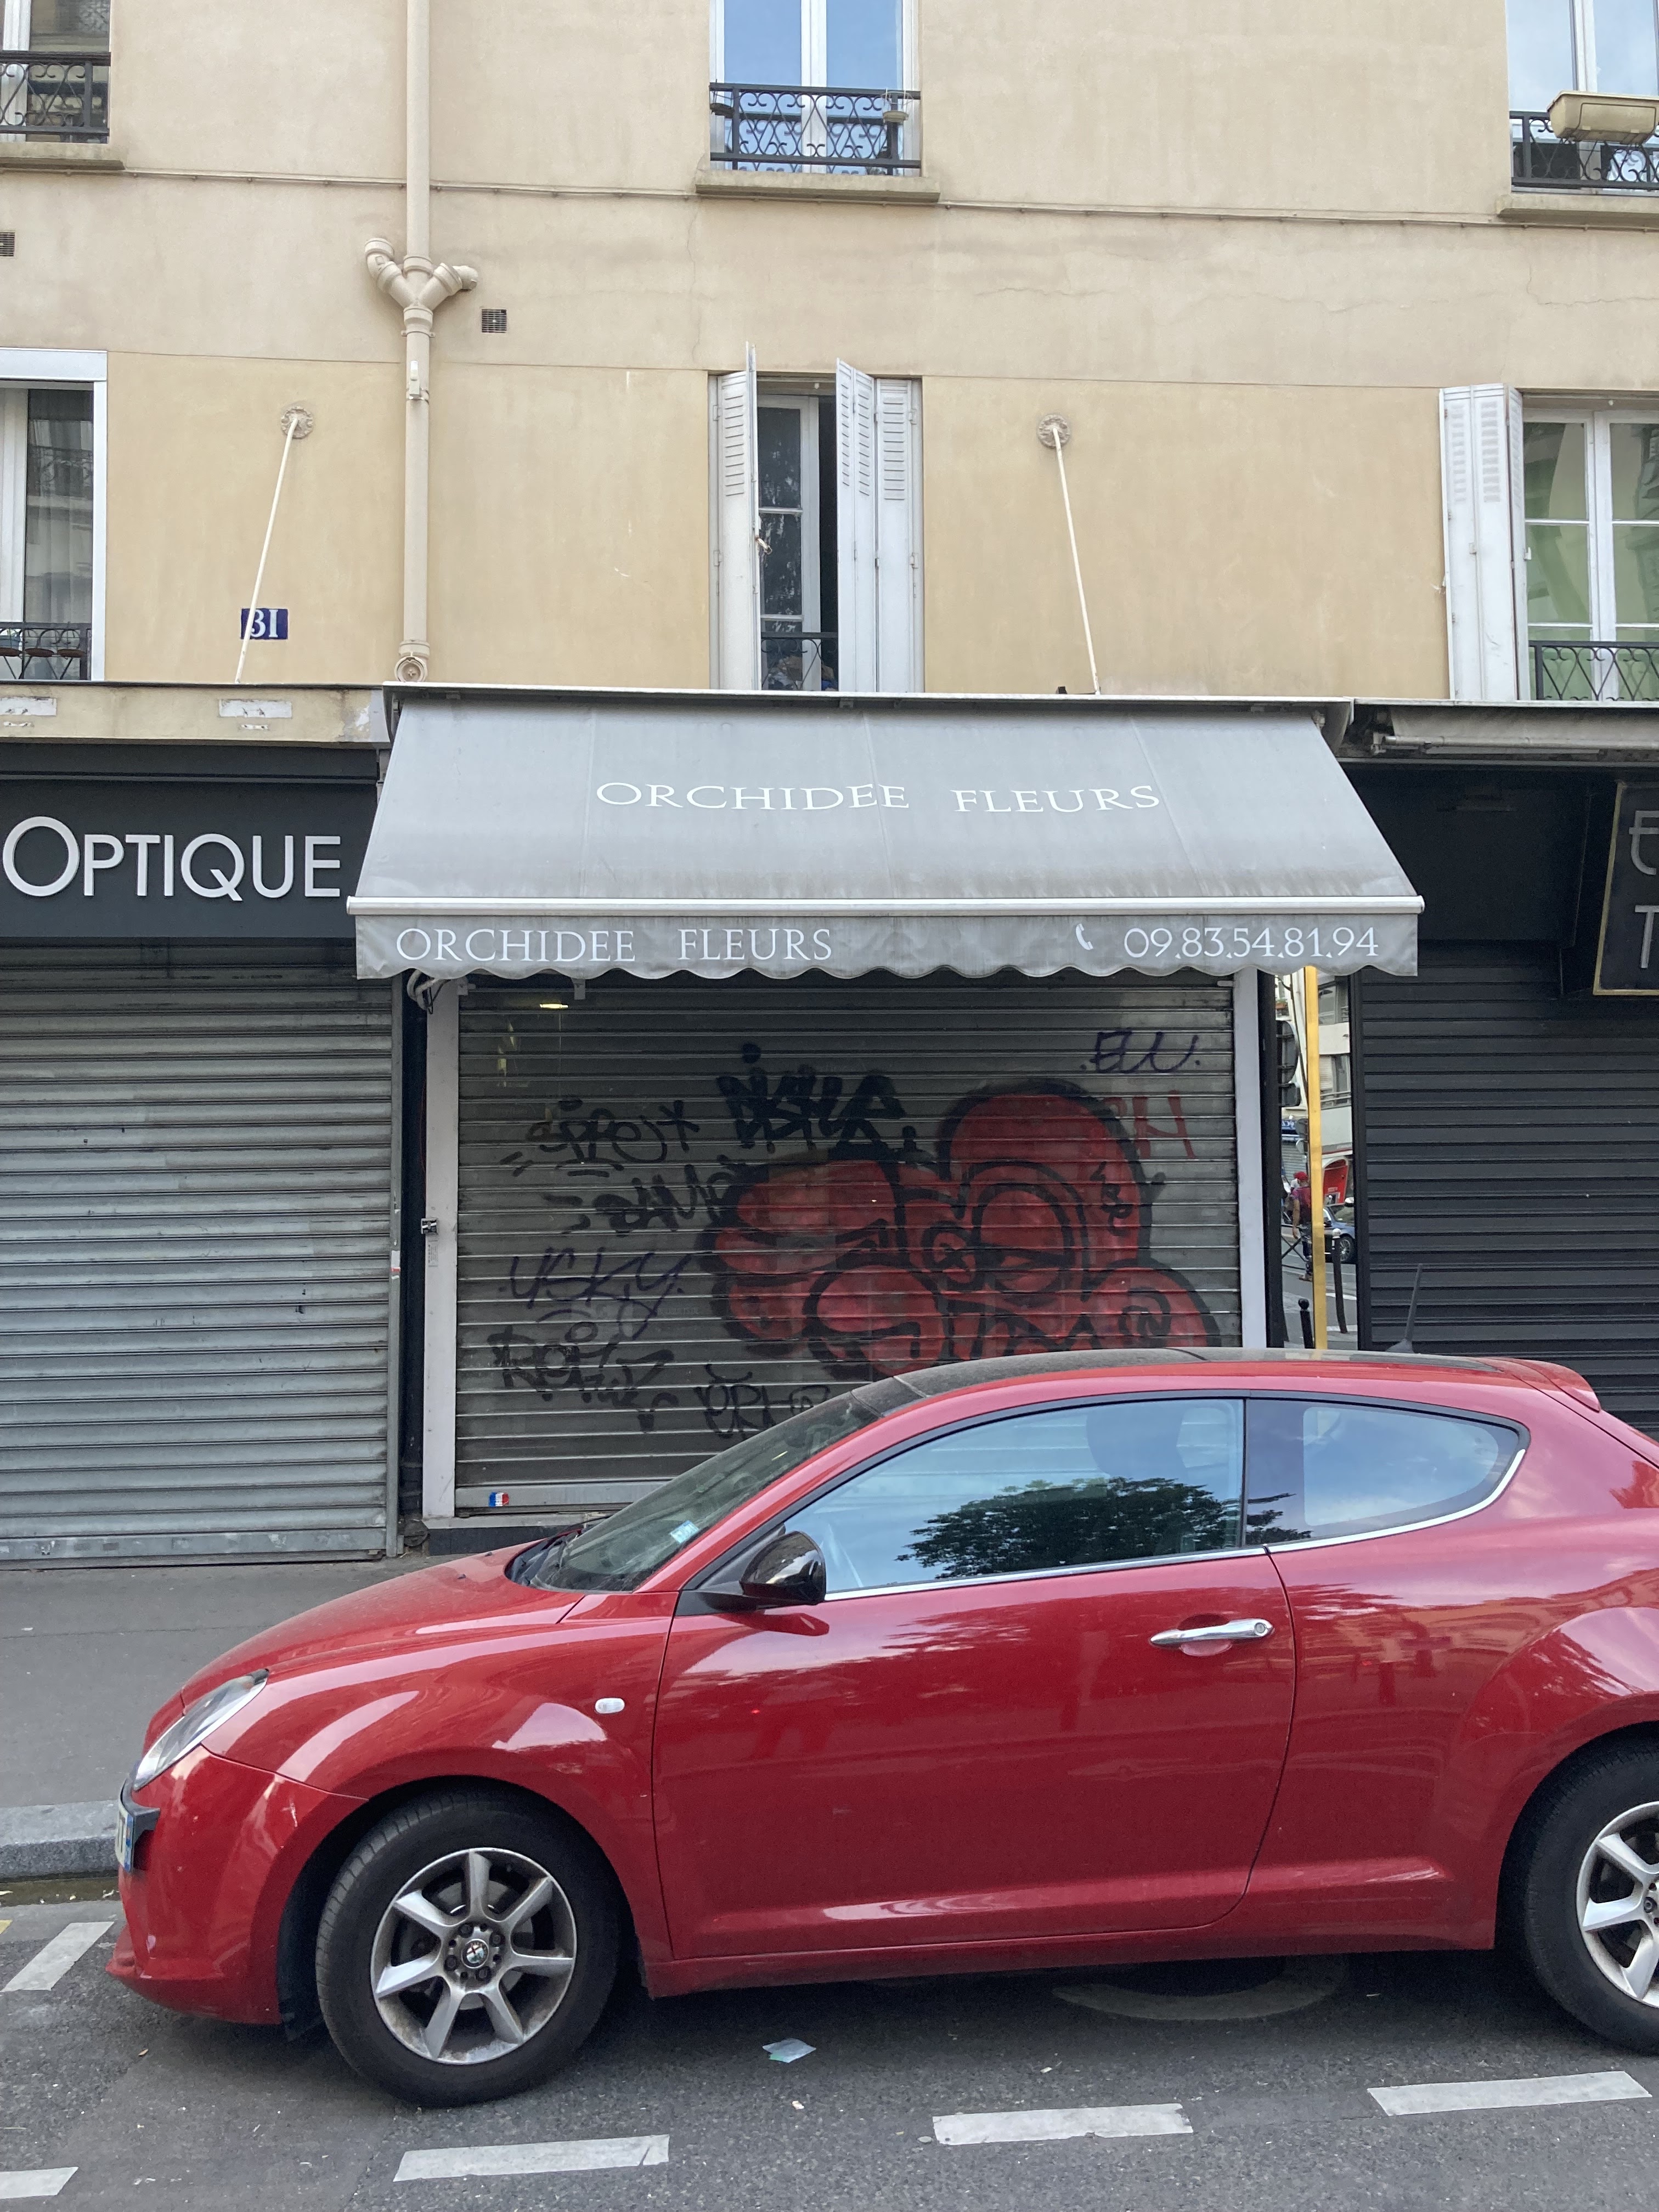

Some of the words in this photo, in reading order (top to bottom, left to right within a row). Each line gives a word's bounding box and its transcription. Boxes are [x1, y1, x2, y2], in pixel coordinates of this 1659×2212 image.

[250, 609, 279, 638] 31
[596, 782, 909, 810] ORCHIDEE
[950, 785, 1160, 813] FLEURS
[2, 816, 341, 901] OPTIQUE
[396, 928, 636, 962] ORCHIDEE
[677, 928, 832, 961] FLEURS
[1123, 927, 1380, 960] 09.83.54.81.94
